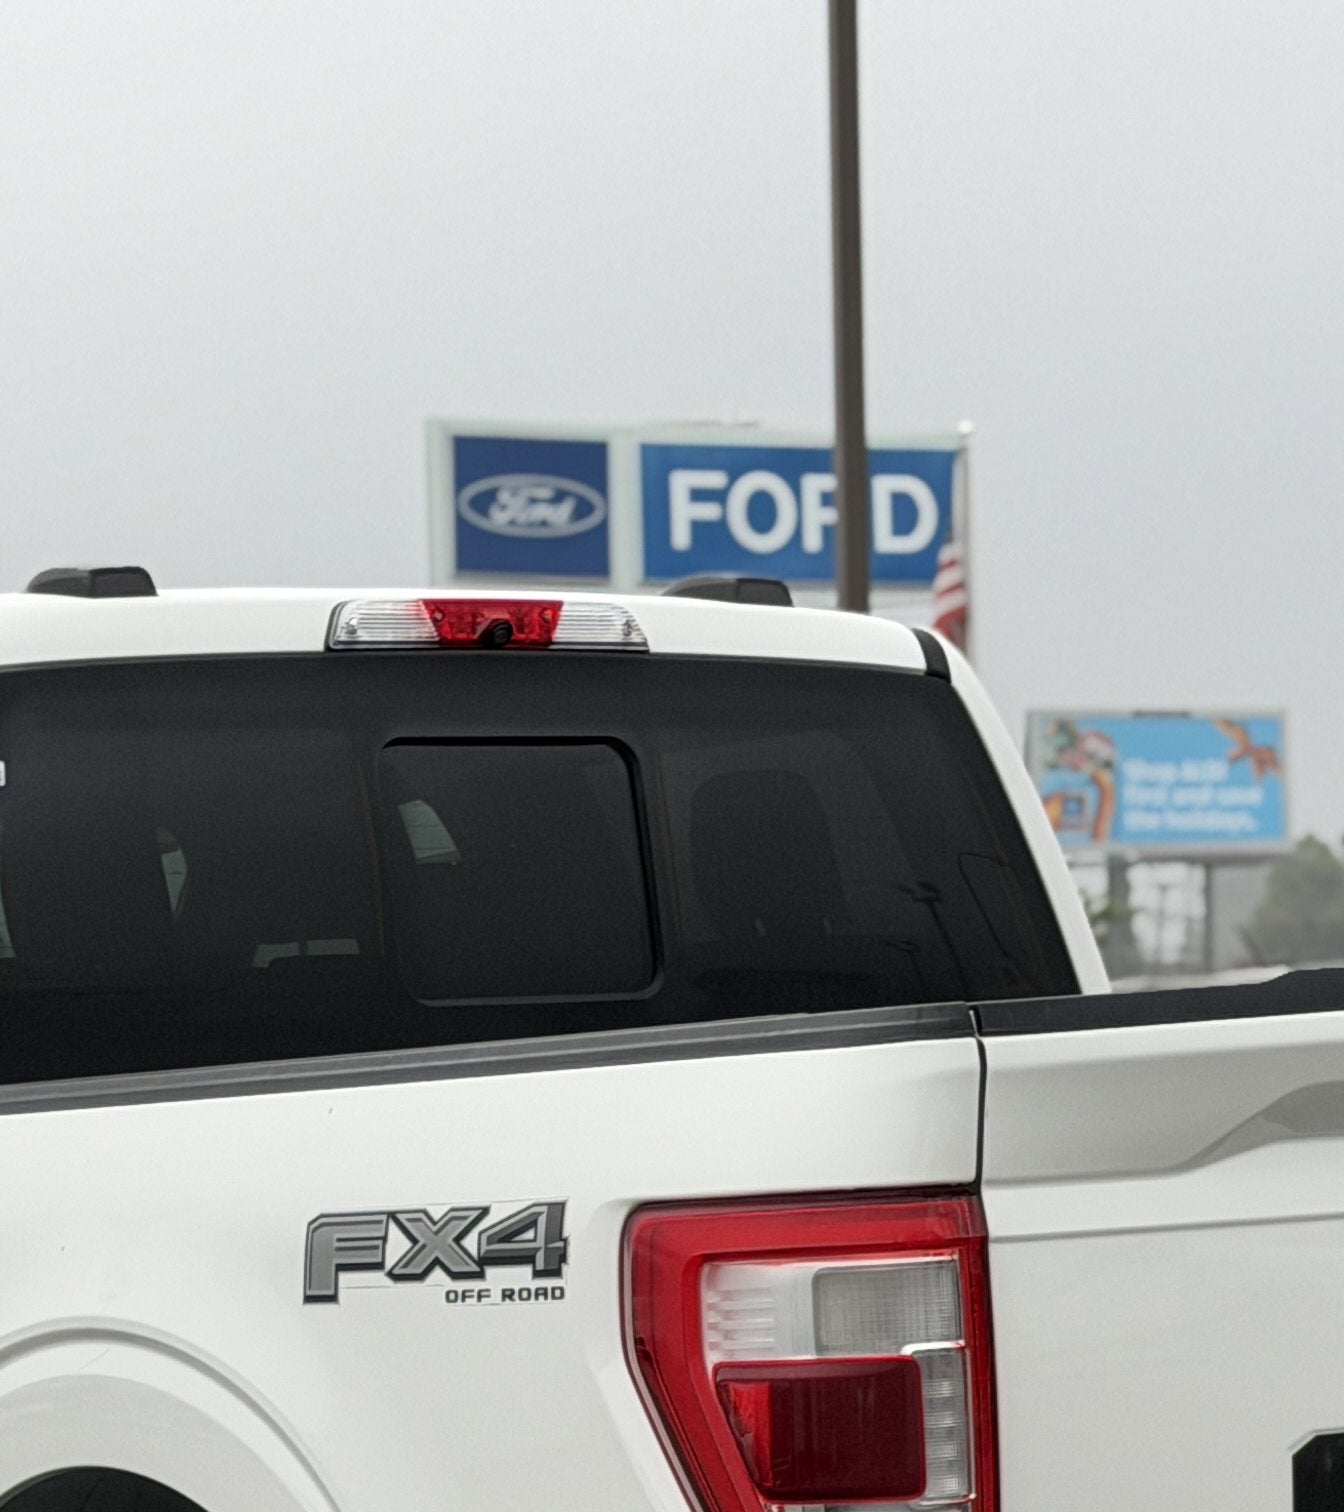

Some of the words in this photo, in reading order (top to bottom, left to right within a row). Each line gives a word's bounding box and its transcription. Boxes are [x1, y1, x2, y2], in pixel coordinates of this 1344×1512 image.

[303, 1199, 569, 1305] FX4
[444, 1289, 492, 1304] OFF
[500, 1286, 566, 1303] ROAD
